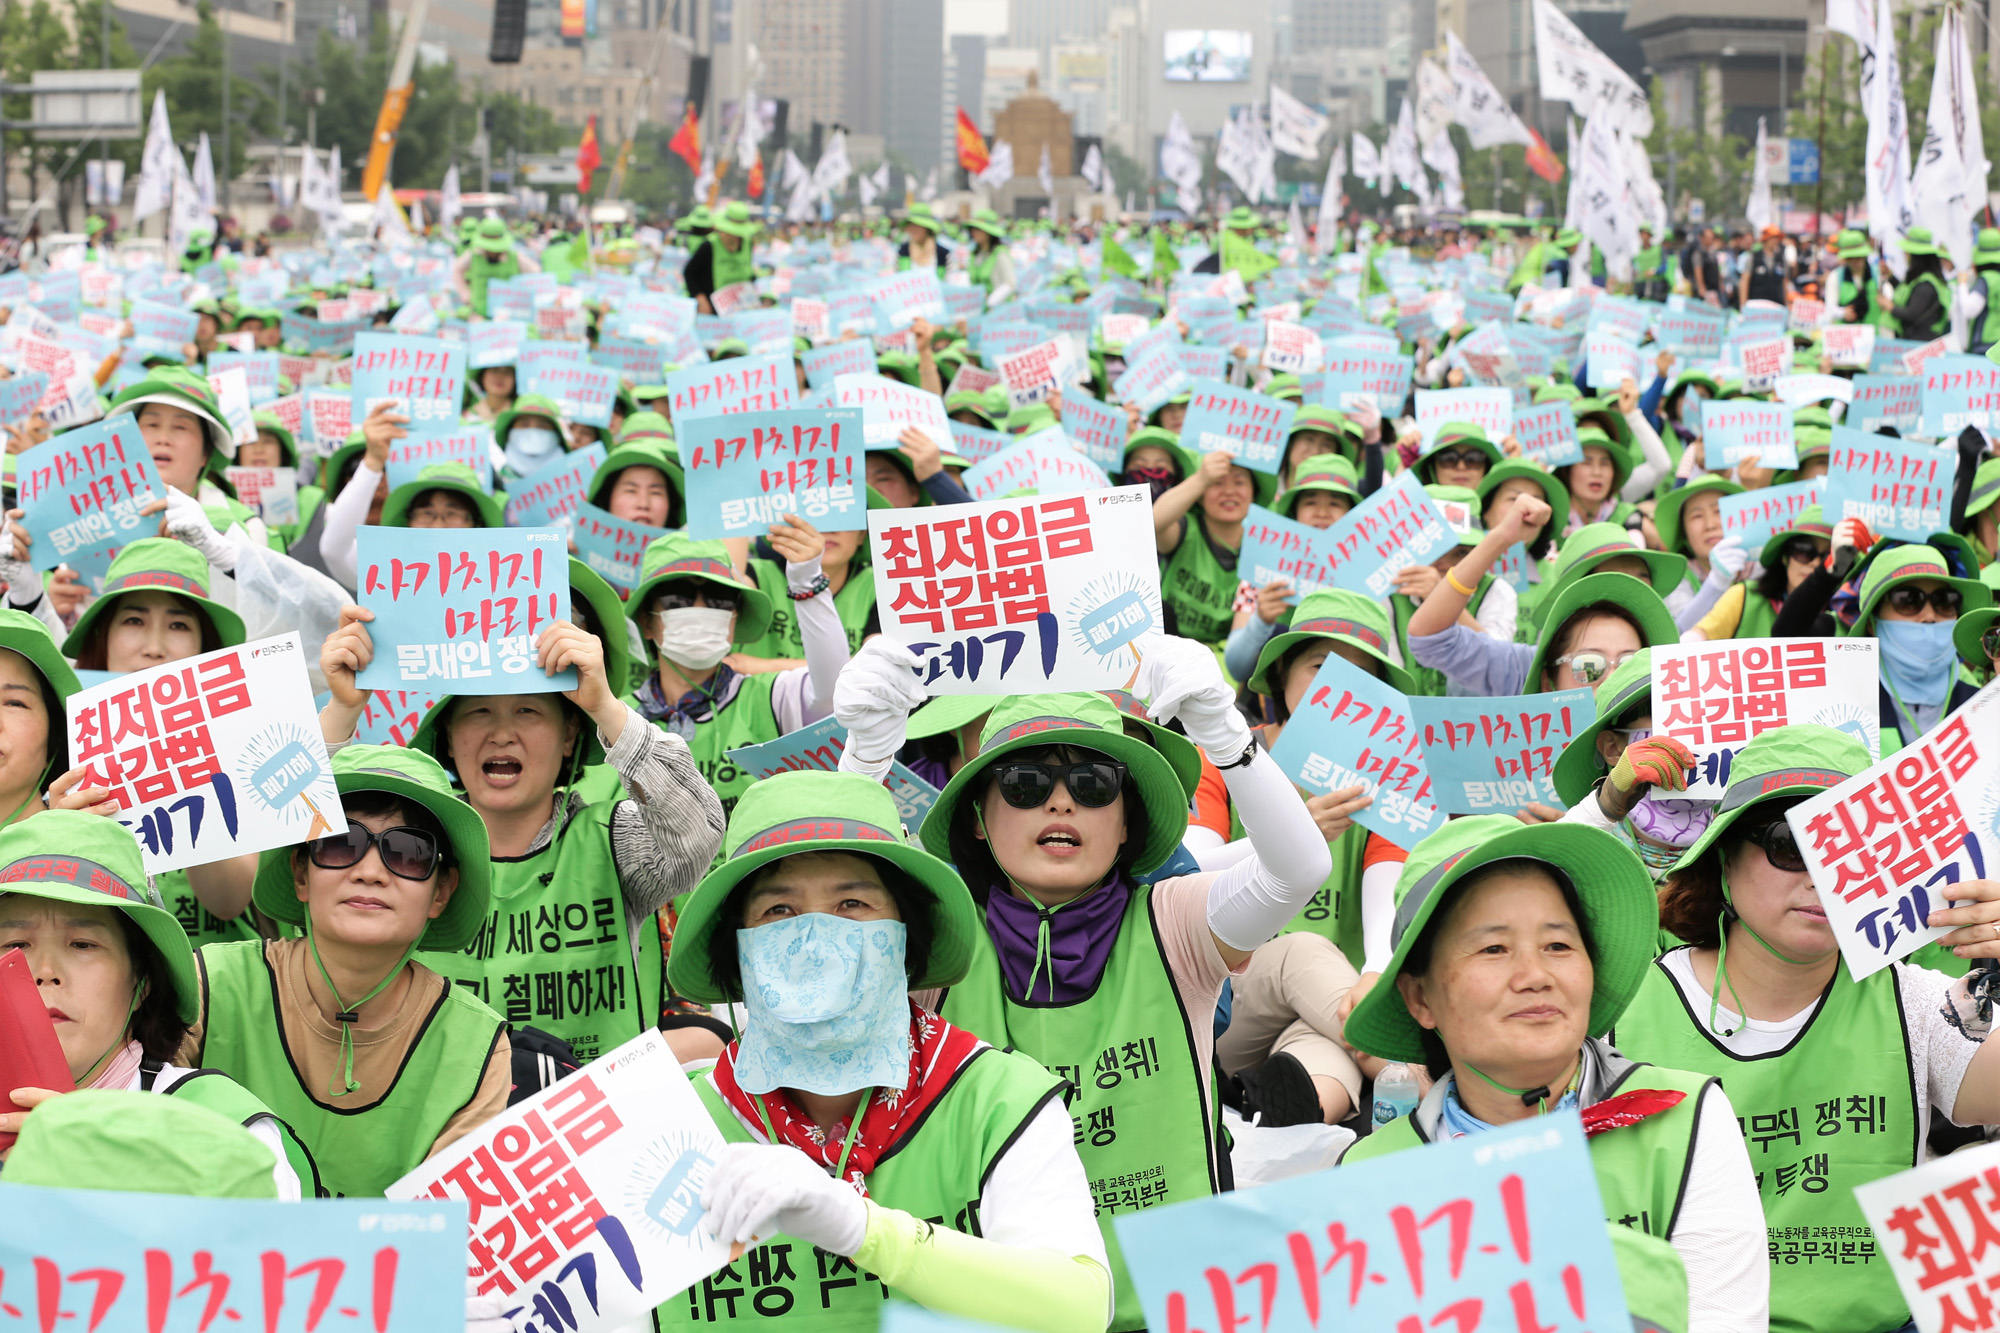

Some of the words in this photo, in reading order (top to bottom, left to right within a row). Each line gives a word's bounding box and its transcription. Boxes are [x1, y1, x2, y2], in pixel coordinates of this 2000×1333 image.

[356, 348, 449, 374] 사기치지
[389, 376, 454, 399] 마라!
[674, 364, 777, 411] 사기치지
[1195, 394, 1282, 425] 사기치지
[692, 423, 840, 469] 사기치지
[1226, 422, 1283, 447] 마라!
[20, 434, 127, 503] 사기치지
[70, 462, 151, 515] 마라!
[761, 456, 853, 494] 마라!
[1833, 448, 1937, 483] 사기치지
[720, 493, 798, 530] 문재인
[802, 484, 856, 517] 정부
[1110, 493, 1143, 505] 민주노총
[1871, 482, 1943, 511] 마라!
[1899, 506, 1941, 532] 정부
[48, 509, 116, 556] 문재인
[880, 496, 1094, 579] 최저임금
[1327, 488, 1412, 569] 사기치지
[1376, 504, 1434, 558] 마라!
[366, 548, 543, 601] 사기치지
[1365, 548, 1416, 596] 문재인
[1407, 519, 1445, 556] 정부
[890, 564, 1051, 633] 삭감법
[1088, 600, 1146, 646] 폐기해
[262, 641, 295, 657] 민주노총
[396, 641, 492, 680] 문재인
[906, 612, 1059, 687] 폐기
[1659, 642, 1827, 702] 최저임금
[74, 651, 252, 764] 최저임금
[1424, 707, 1572, 751] 사기치지
[1662, 694, 1789, 745] 삭감법
[260, 752, 313, 801] 폐기해
[1462, 780, 1537, 808] 문재인
[1804, 713, 1980, 868] 최저임금
[1378, 788, 1434, 833] 정부
[1831, 791, 1970, 905] 삭감법
[1855, 831, 1986, 955] 폐기
[505, 897, 618, 954] 세상으로
[503, 964, 625, 1022] 철폐하자!
[1815, 1095, 1886, 1136] 쟁취!
[1109, 1165, 1165, 1188] 교육공무직으로!
